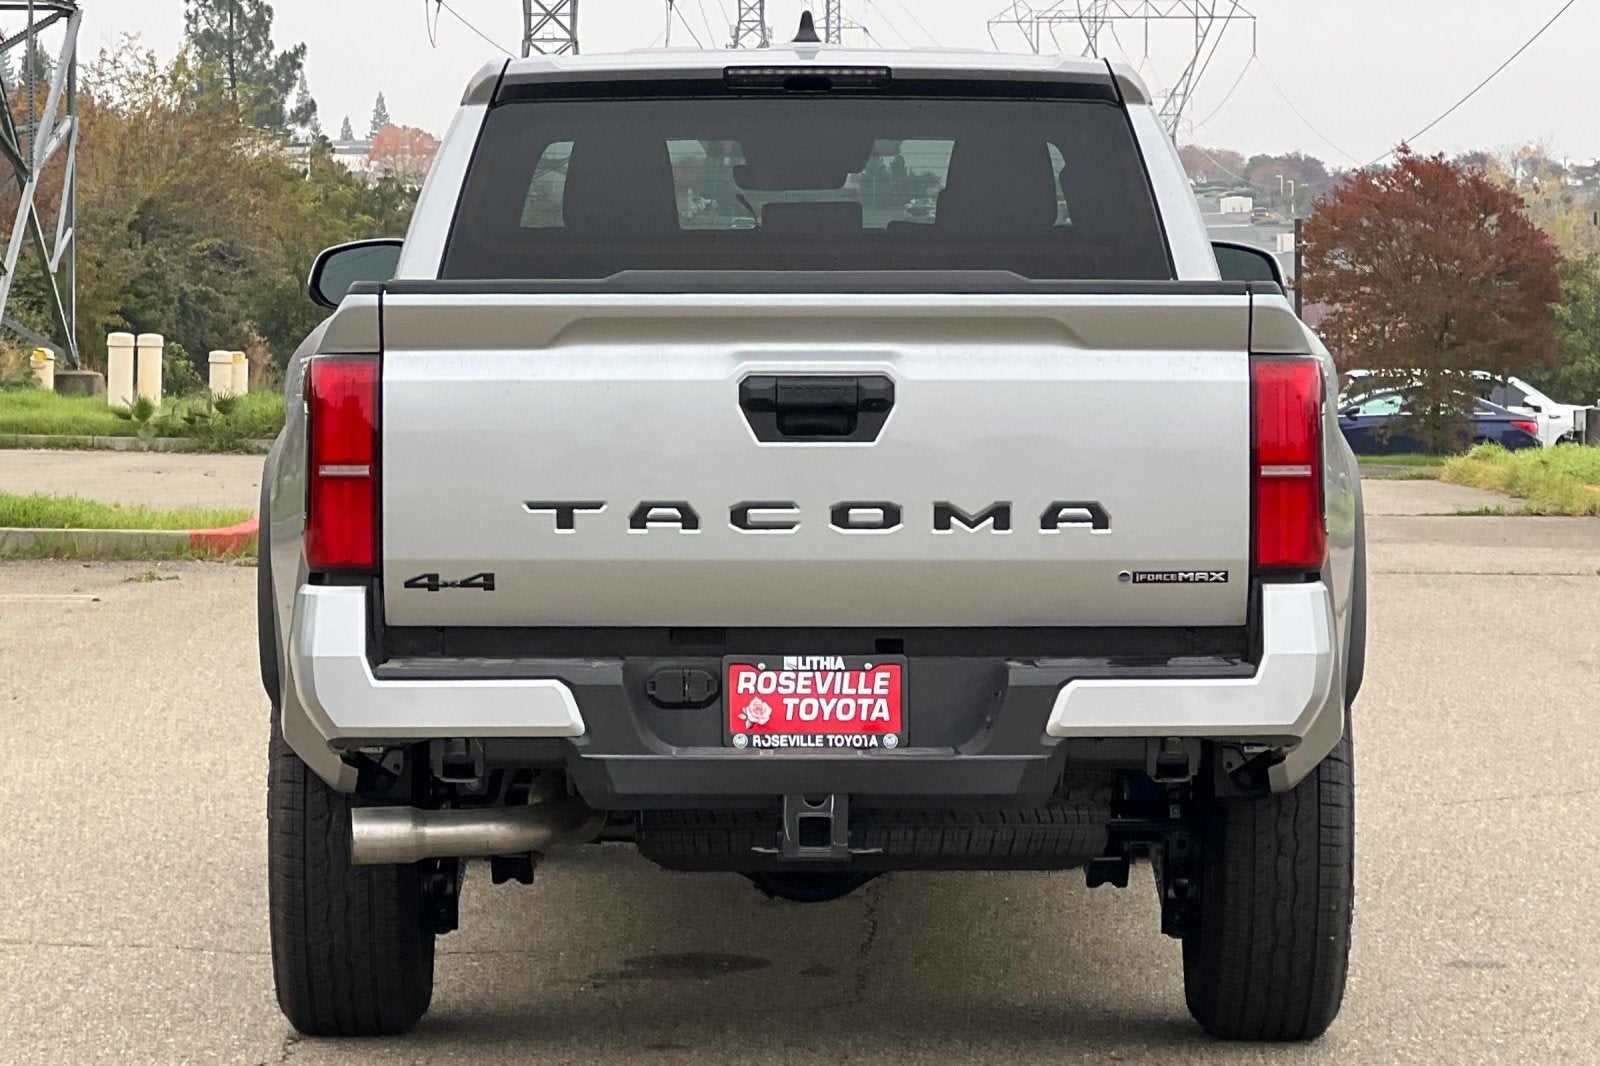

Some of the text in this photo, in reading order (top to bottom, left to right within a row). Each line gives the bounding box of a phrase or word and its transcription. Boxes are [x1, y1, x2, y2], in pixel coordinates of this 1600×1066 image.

[522, 500, 1112, 534] TACOMA
[798, 656, 846, 671] LITHIA
[737, 671, 891, 695] ROSEVILLE
[783, 698, 890, 721] TOYOTA
[752, 735, 878, 747] ROSEVILLE TOYOTA
